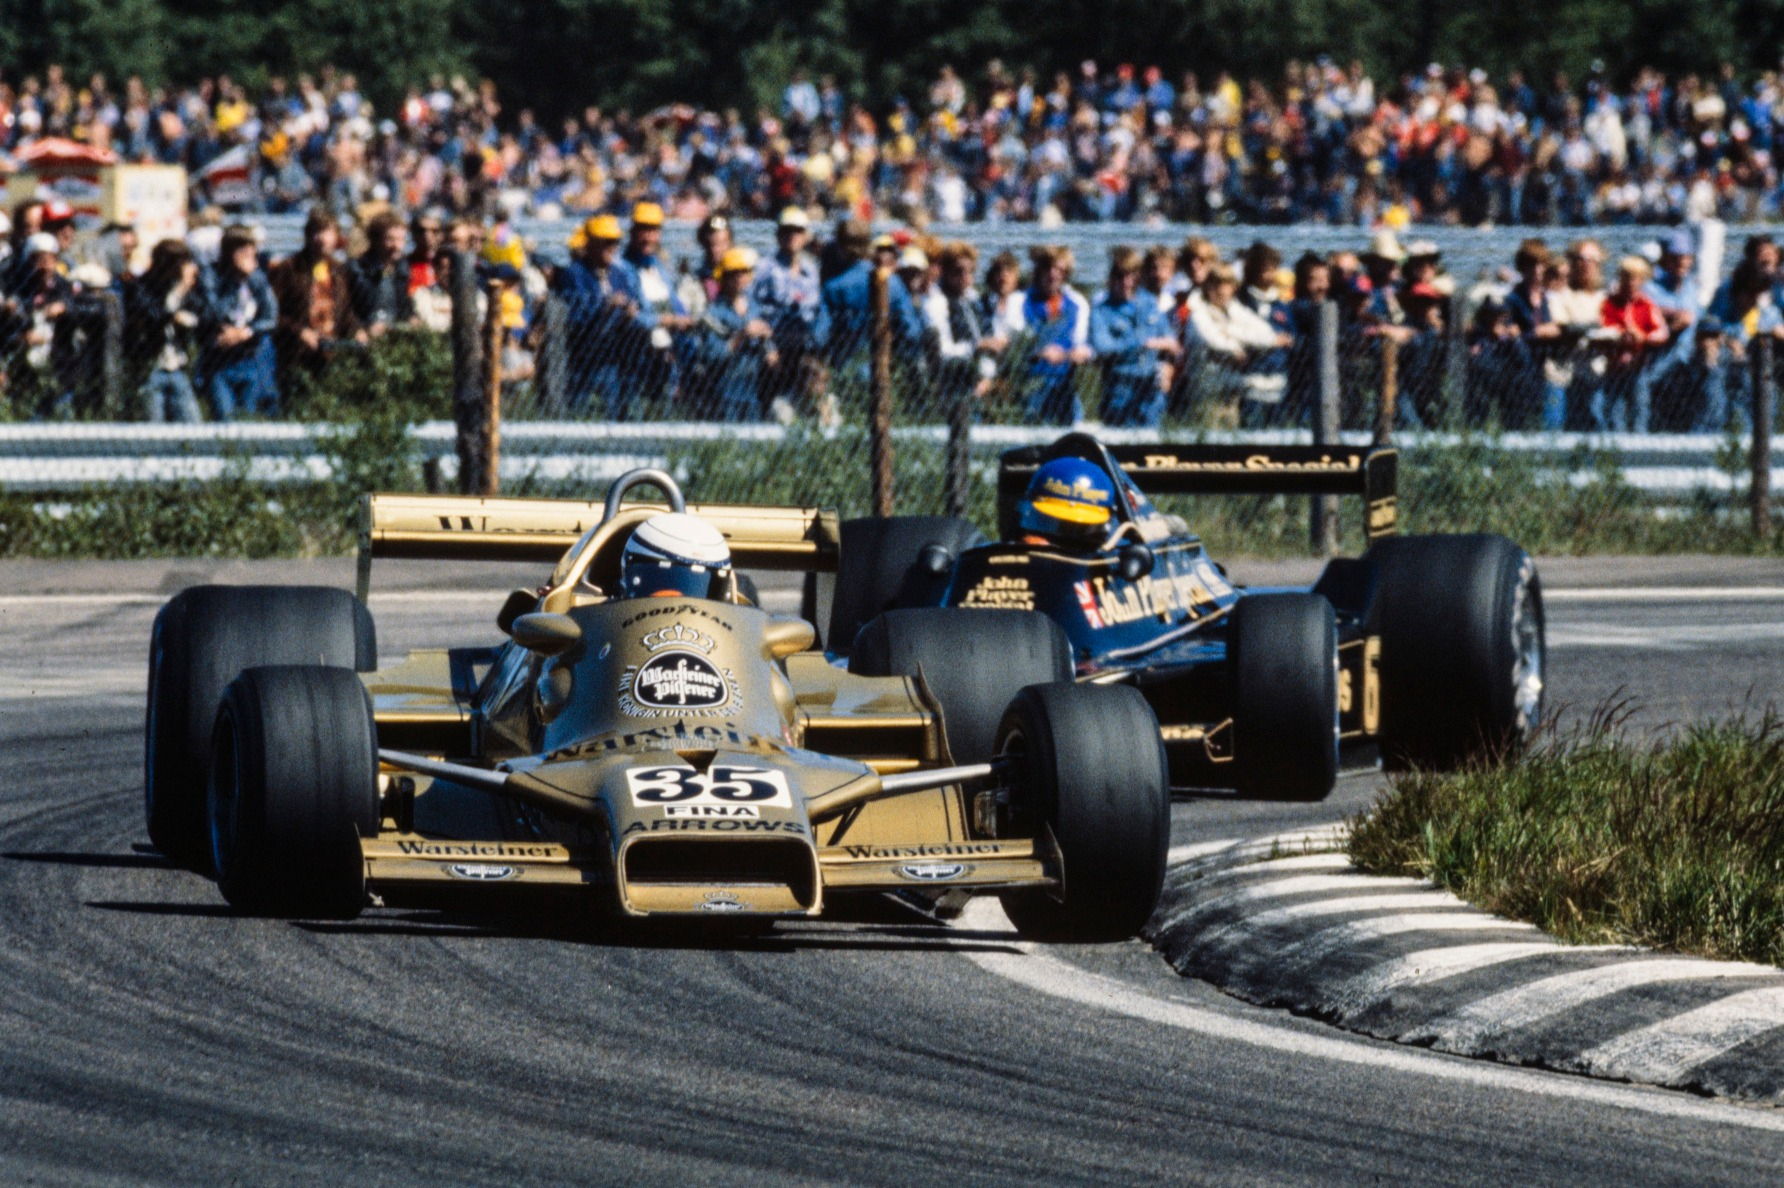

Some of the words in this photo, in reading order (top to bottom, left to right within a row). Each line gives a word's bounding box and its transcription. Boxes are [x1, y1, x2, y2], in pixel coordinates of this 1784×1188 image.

[621, 605, 734, 632] GOODYEAR
[641, 658, 721, 688] Warsteiner
[633, 767, 779, 802] 35
[665, 806, 757, 817] FINA
[622, 819, 806, 836] ARROWS
[397, 840, 559, 858] Warsteiner
[844, 842, 1004, 859] Warsteiner
